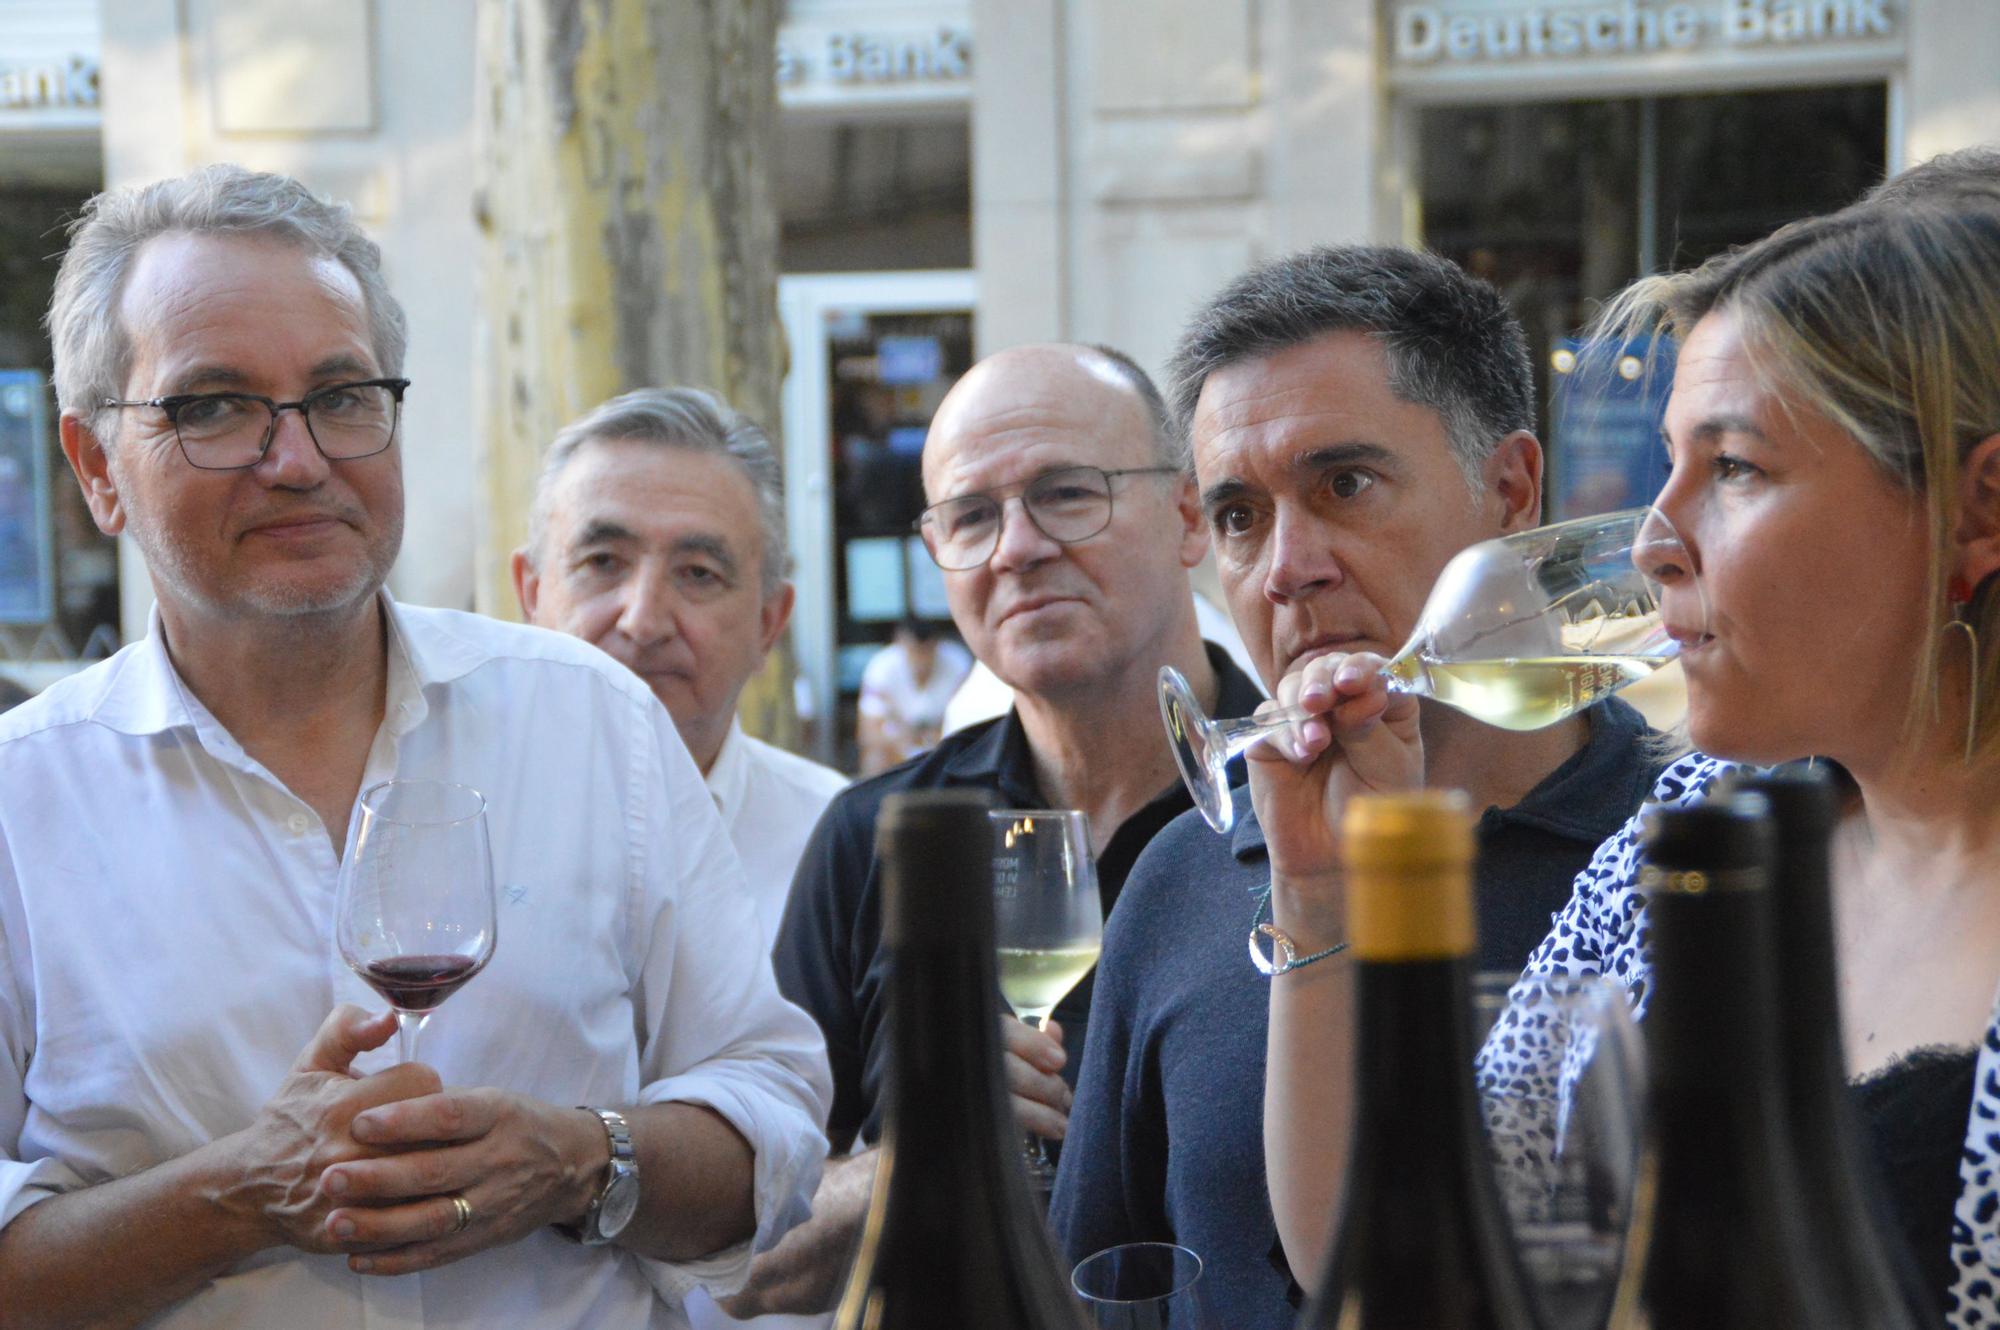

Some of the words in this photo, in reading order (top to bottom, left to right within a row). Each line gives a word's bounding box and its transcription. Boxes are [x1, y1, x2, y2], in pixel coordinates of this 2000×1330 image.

[828, 28, 971, 78] Bank
[1394, 0, 1700, 58] Deutsche
[1724, 0, 1891, 41] Bank
[0, 56, 100, 104] ank
